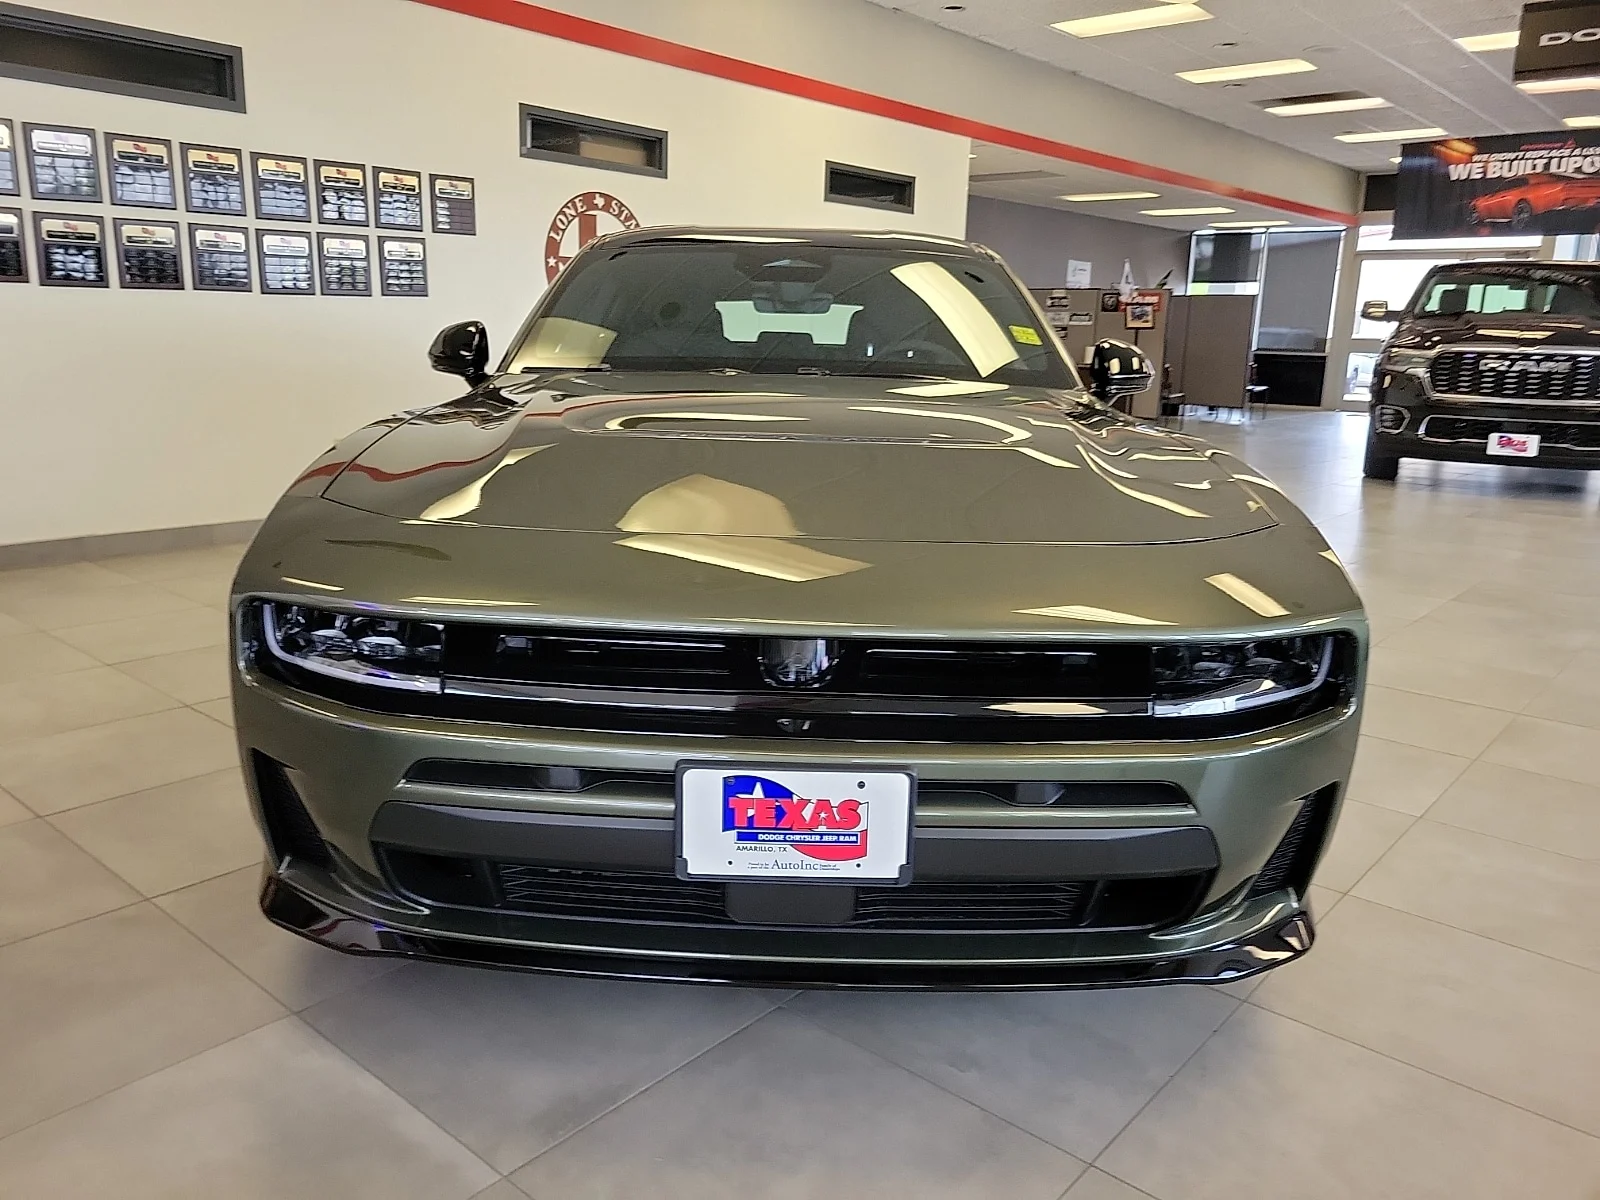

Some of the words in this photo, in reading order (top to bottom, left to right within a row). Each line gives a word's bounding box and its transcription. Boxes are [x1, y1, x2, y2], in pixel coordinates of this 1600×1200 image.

[1448, 163, 1484, 181] WE
[1486, 158, 1549, 178] BUILT
[549, 196, 587, 243] LONE
[1478, 359, 1573, 373] RAM
[728, 797, 862, 830] TEXAS
[785, 834, 821, 842] CHRYSLER
[735, 845, 776, 853] AMARILLO,
[771, 859, 819, 871] AutoInc
